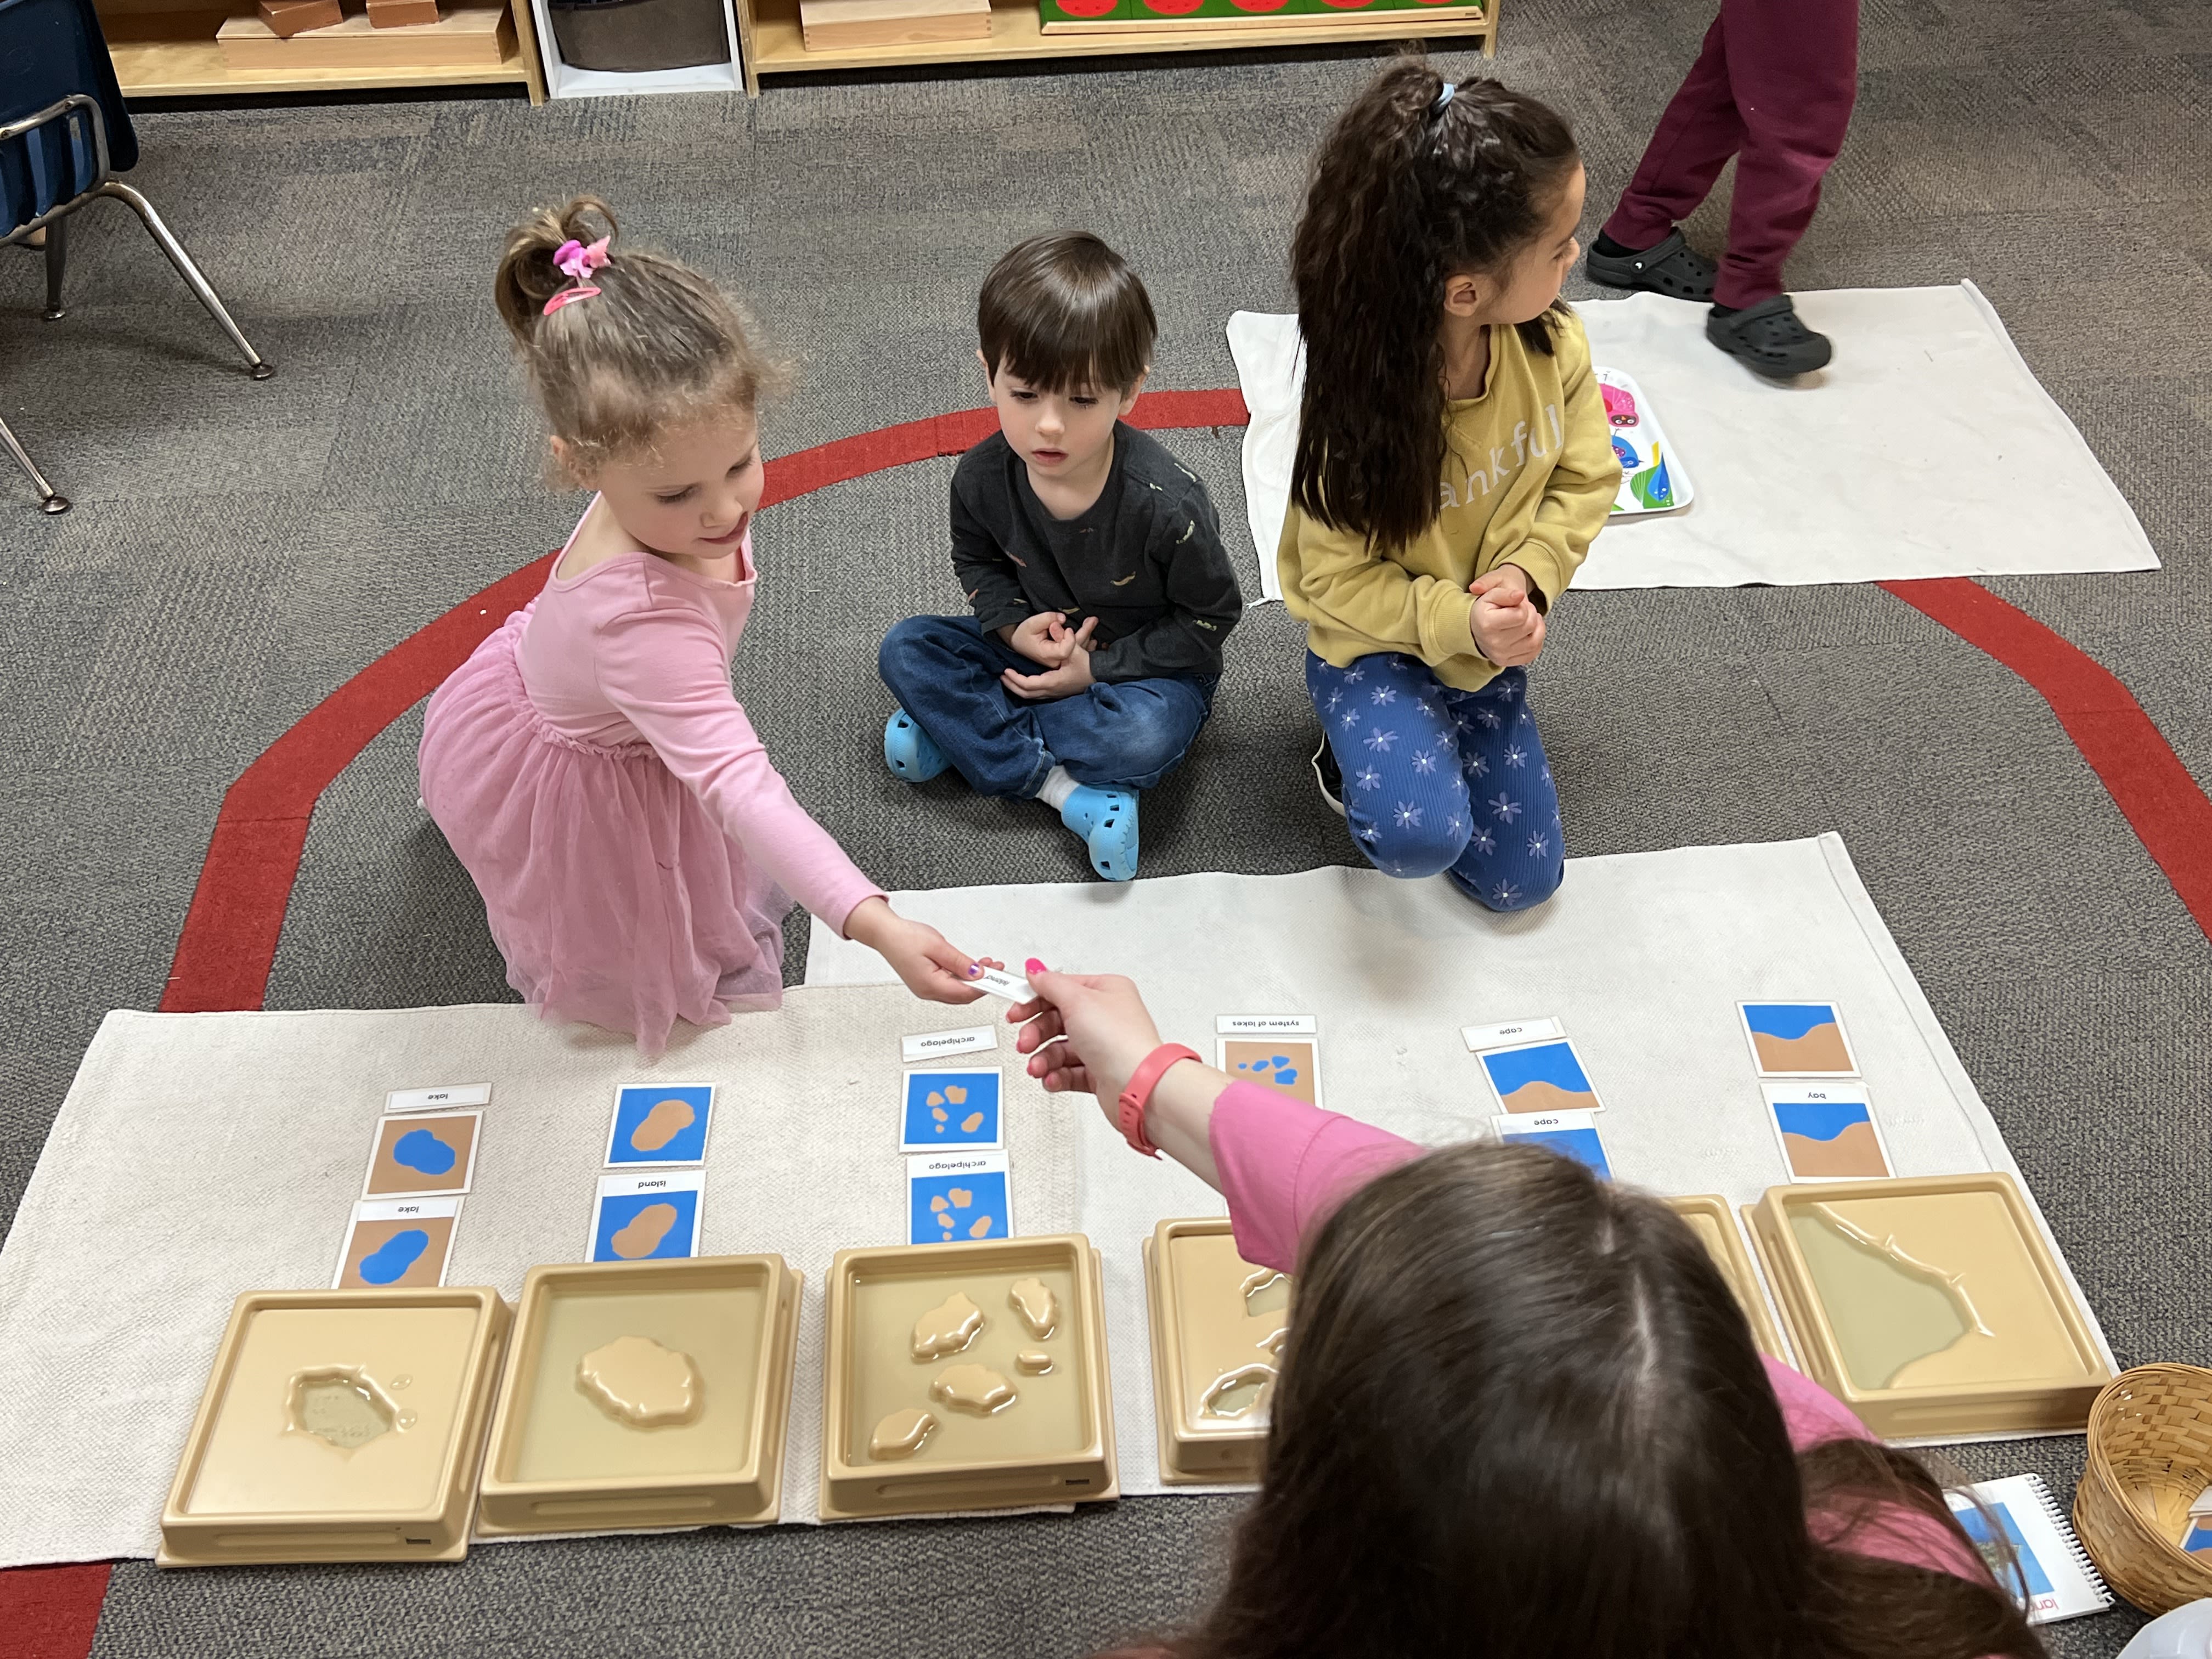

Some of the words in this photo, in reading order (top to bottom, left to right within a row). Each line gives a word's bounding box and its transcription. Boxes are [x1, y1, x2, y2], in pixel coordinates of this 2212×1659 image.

[1440, 403, 1563, 510] ankful
[921, 1035, 975, 1047] archipelago
[928, 1160, 986, 1170] archipelago
[638, 1181, 667, 1189] island
